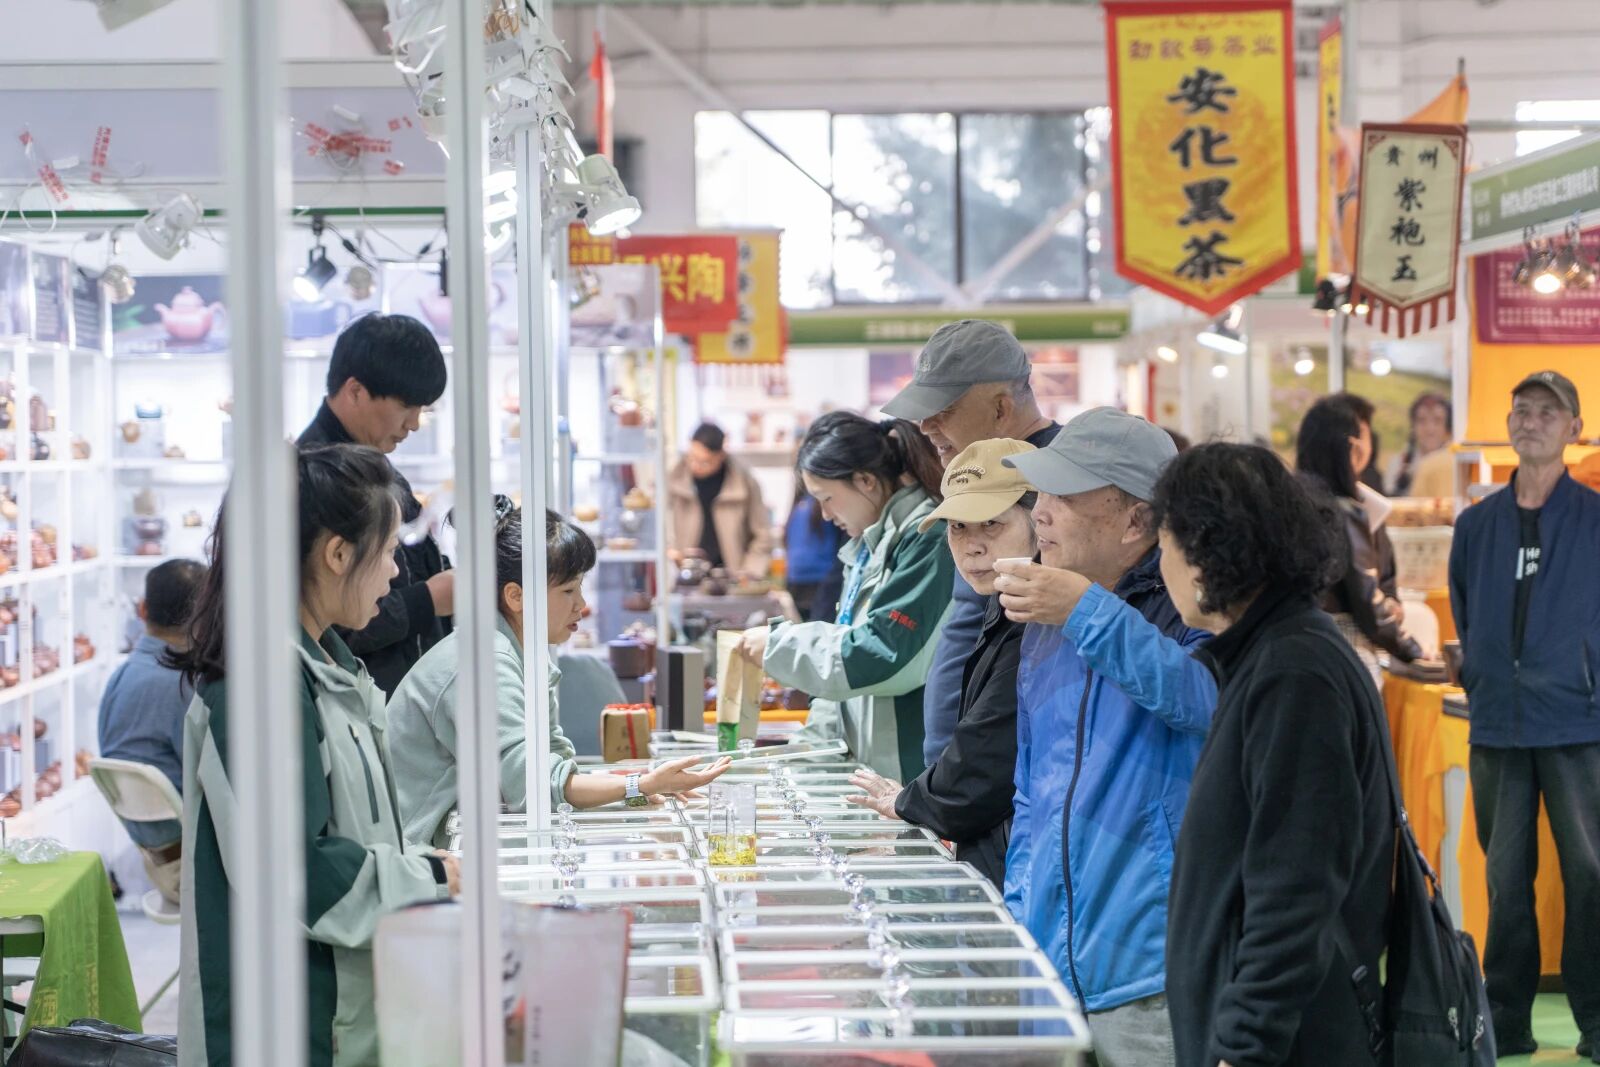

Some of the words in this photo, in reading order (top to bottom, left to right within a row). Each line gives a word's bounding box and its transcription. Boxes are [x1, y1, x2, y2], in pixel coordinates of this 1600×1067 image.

[1168, 68, 1243, 282] 安化黑茶
[622, 253, 726, 304] 兴陶
